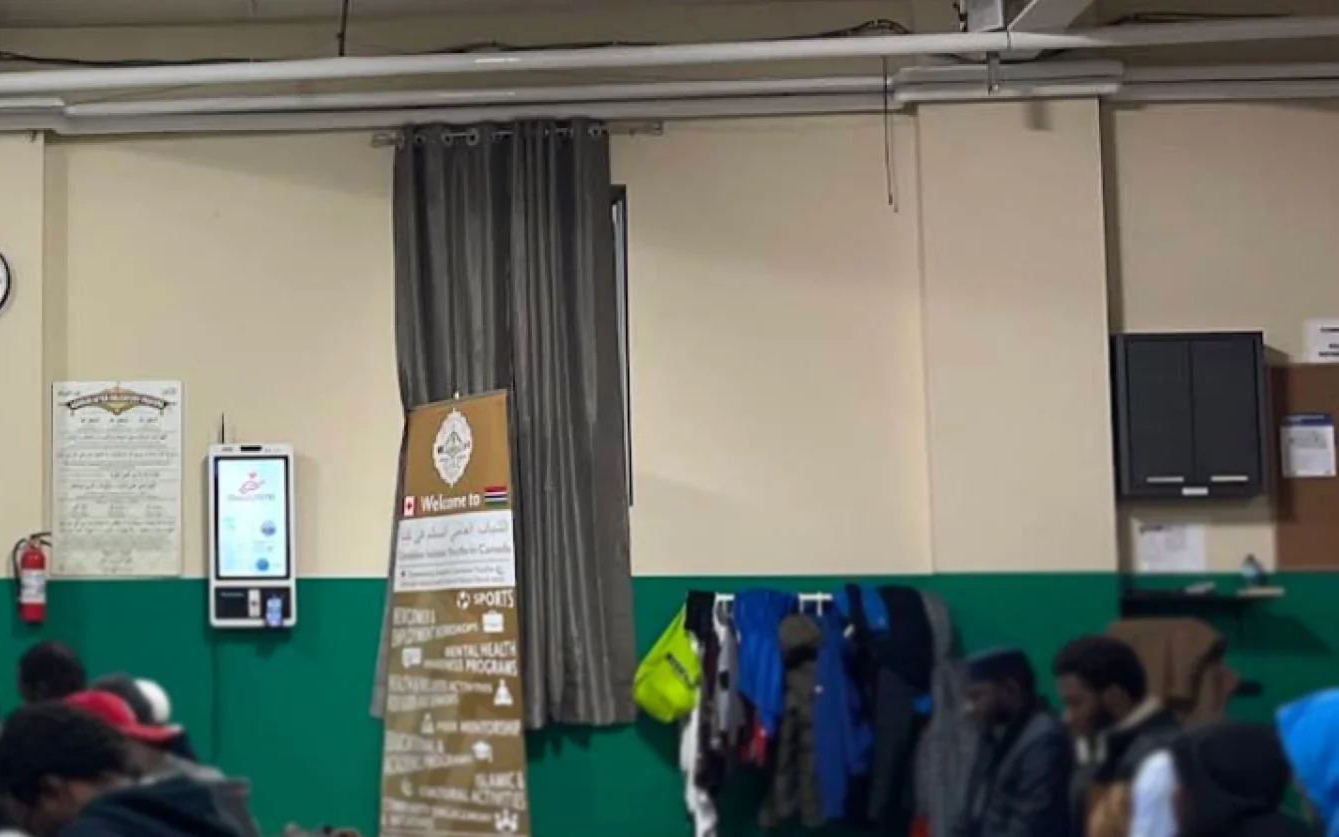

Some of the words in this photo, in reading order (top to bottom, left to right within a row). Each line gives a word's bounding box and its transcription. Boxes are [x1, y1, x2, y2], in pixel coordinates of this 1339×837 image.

[421, 494, 467, 511] Welcome
[469, 493, 480, 507] to
[473, 589, 514, 608] SPORTS
[480, 640, 516, 658] HEALTH
[465, 659, 518, 677] PROGRAMS
